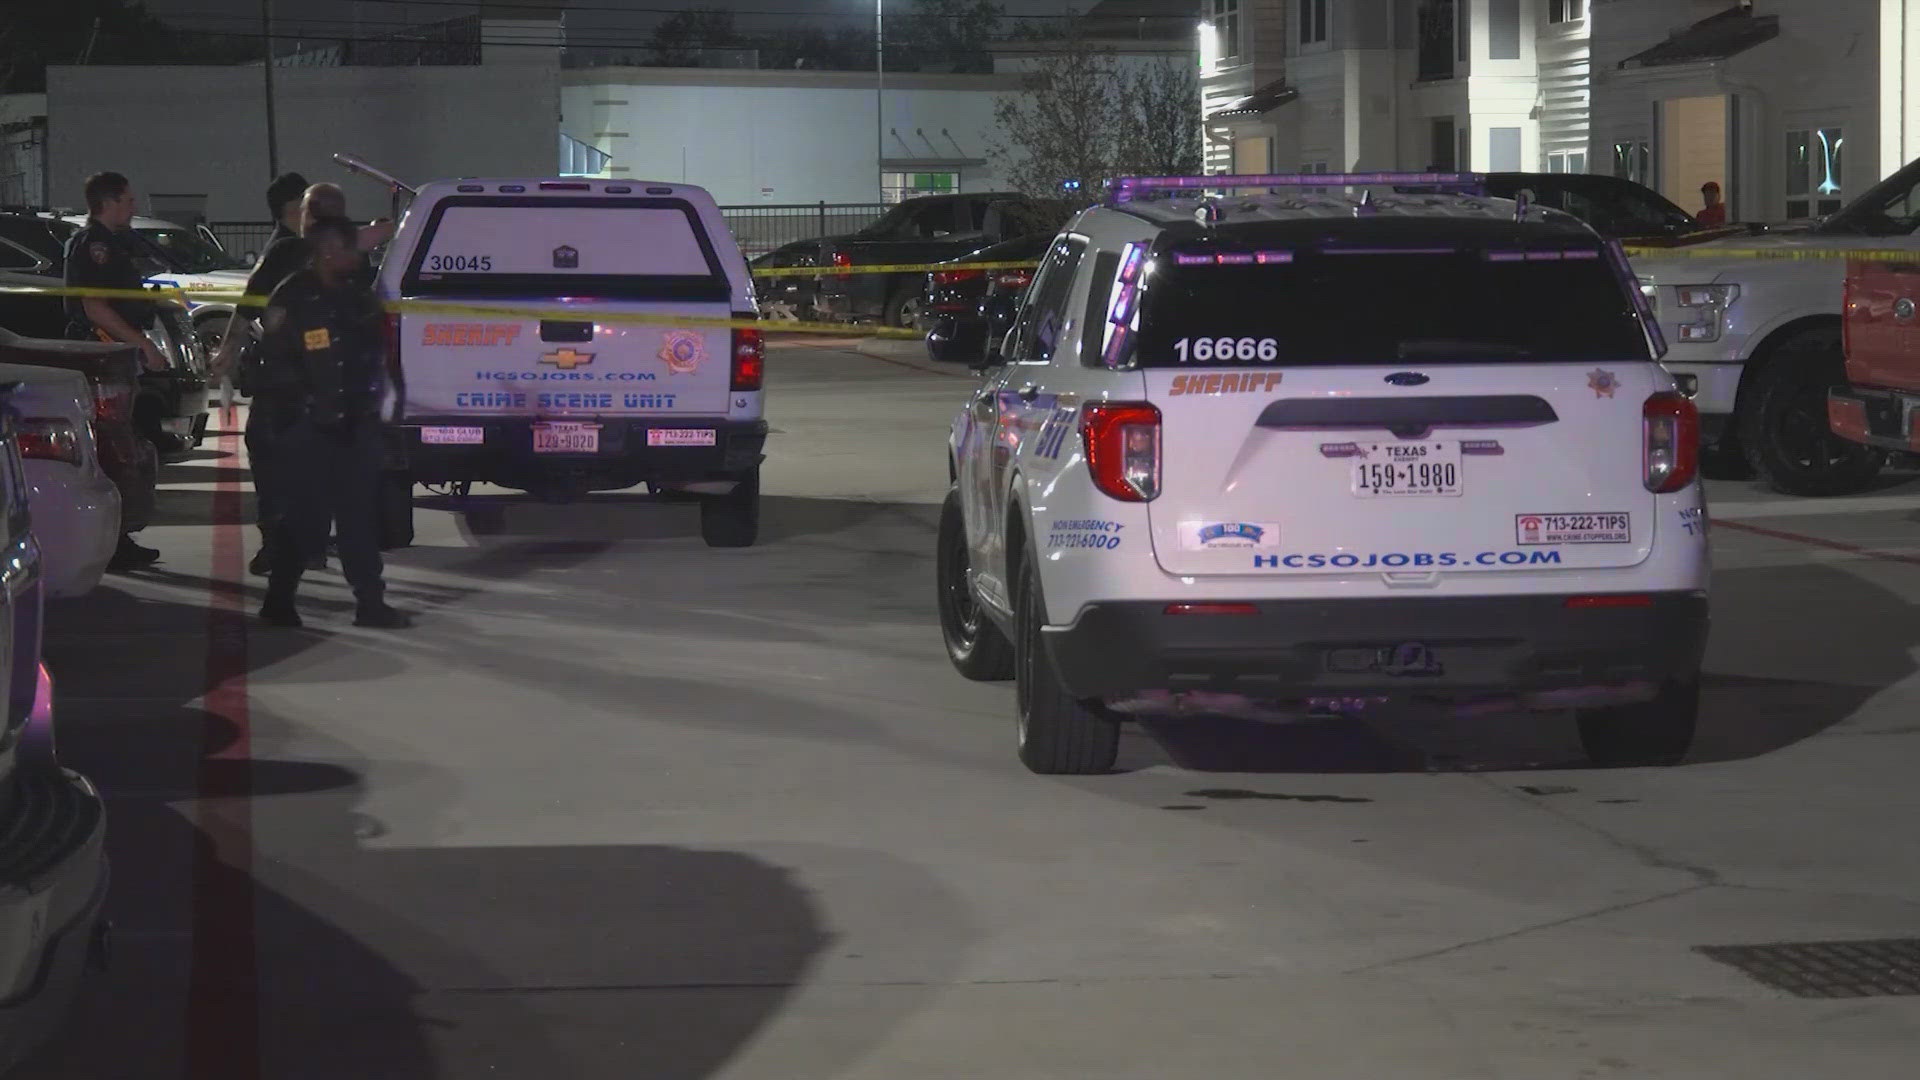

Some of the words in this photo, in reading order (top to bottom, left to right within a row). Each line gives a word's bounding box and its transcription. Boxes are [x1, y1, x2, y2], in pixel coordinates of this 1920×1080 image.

[430, 255, 492, 271] 30045
[422, 323, 521, 346] SHERIFF
[1173, 337, 1278, 361] 16666
[476, 371, 656, 381] HCSOJOBS.COM
[1168, 372, 1283, 396] SHERIFF
[456, 392, 526, 407] CRIME
[537, 393, 613, 408] SCENE
[623, 394, 677, 408] UNIT
[1385, 446, 1427, 457] TEXAS
[1359, 463, 1395, 488] 159
[1407, 462, 1456, 488] 1980
[1545, 515, 1626, 531] 713-222-TIPS
[1253, 550, 1563, 570] HCSOJOBS.COM
